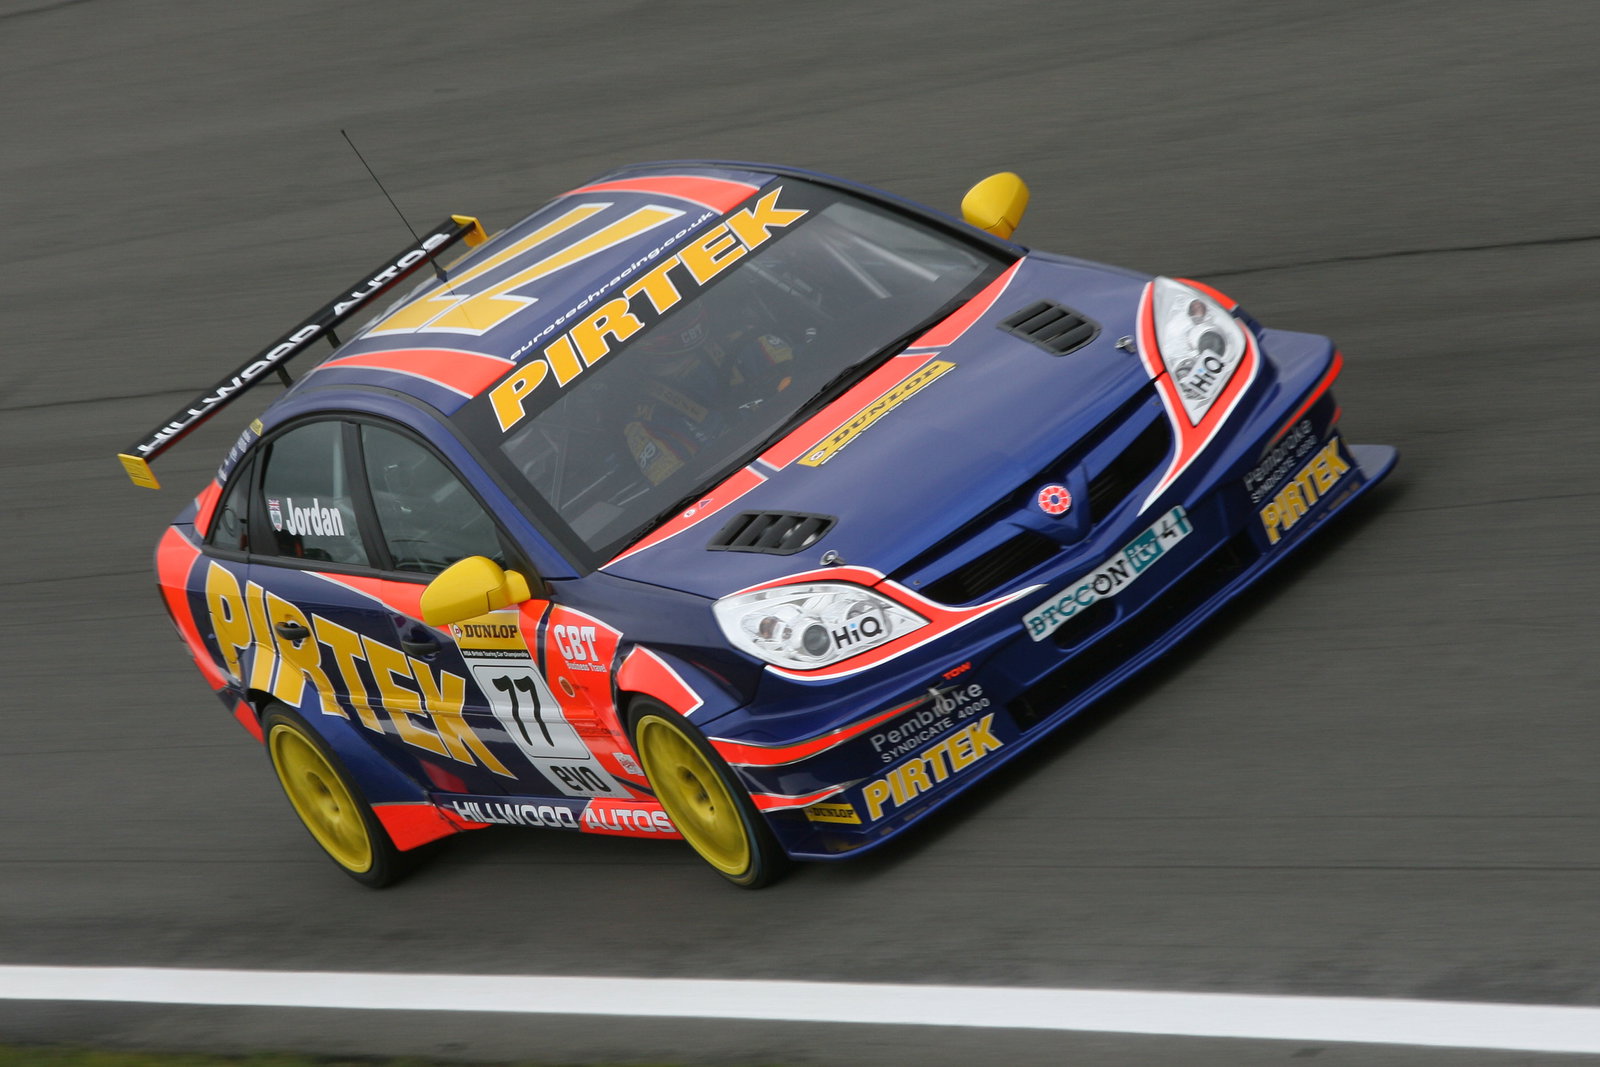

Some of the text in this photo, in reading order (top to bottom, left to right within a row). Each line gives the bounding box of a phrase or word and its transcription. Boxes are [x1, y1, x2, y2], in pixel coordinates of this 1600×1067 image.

[488, 185, 810, 433] PIRTEK
[510, 211, 714, 361] eurotechracing.co.uk
[137, 324, 321, 456] HILLWOOD
[334, 233, 450, 317] AUTOS
[1189, 356, 1225, 394] HiQ
[830, 364, 941, 445] DUNLOP
[286, 497, 345, 536] Jordan
[1259, 436, 1351, 545] PIRTEK
[463, 624, 518, 639] DUNLOP
[553, 624, 599, 662] CBT
[832, 616, 884, 650] HiQ
[205, 560, 519, 781] PIRTEK
[492, 674, 555, 747] 77
[870, 683, 984, 753] Pembroke
[881, 697, 990, 763] SYNDICATE 4000
[549, 765, 612, 792] evo
[862, 712, 1004, 822] PIRTEK
[452, 800, 677, 833] HILLWOOD AUTOS
[813, 807, 855, 819] DUNLOP
